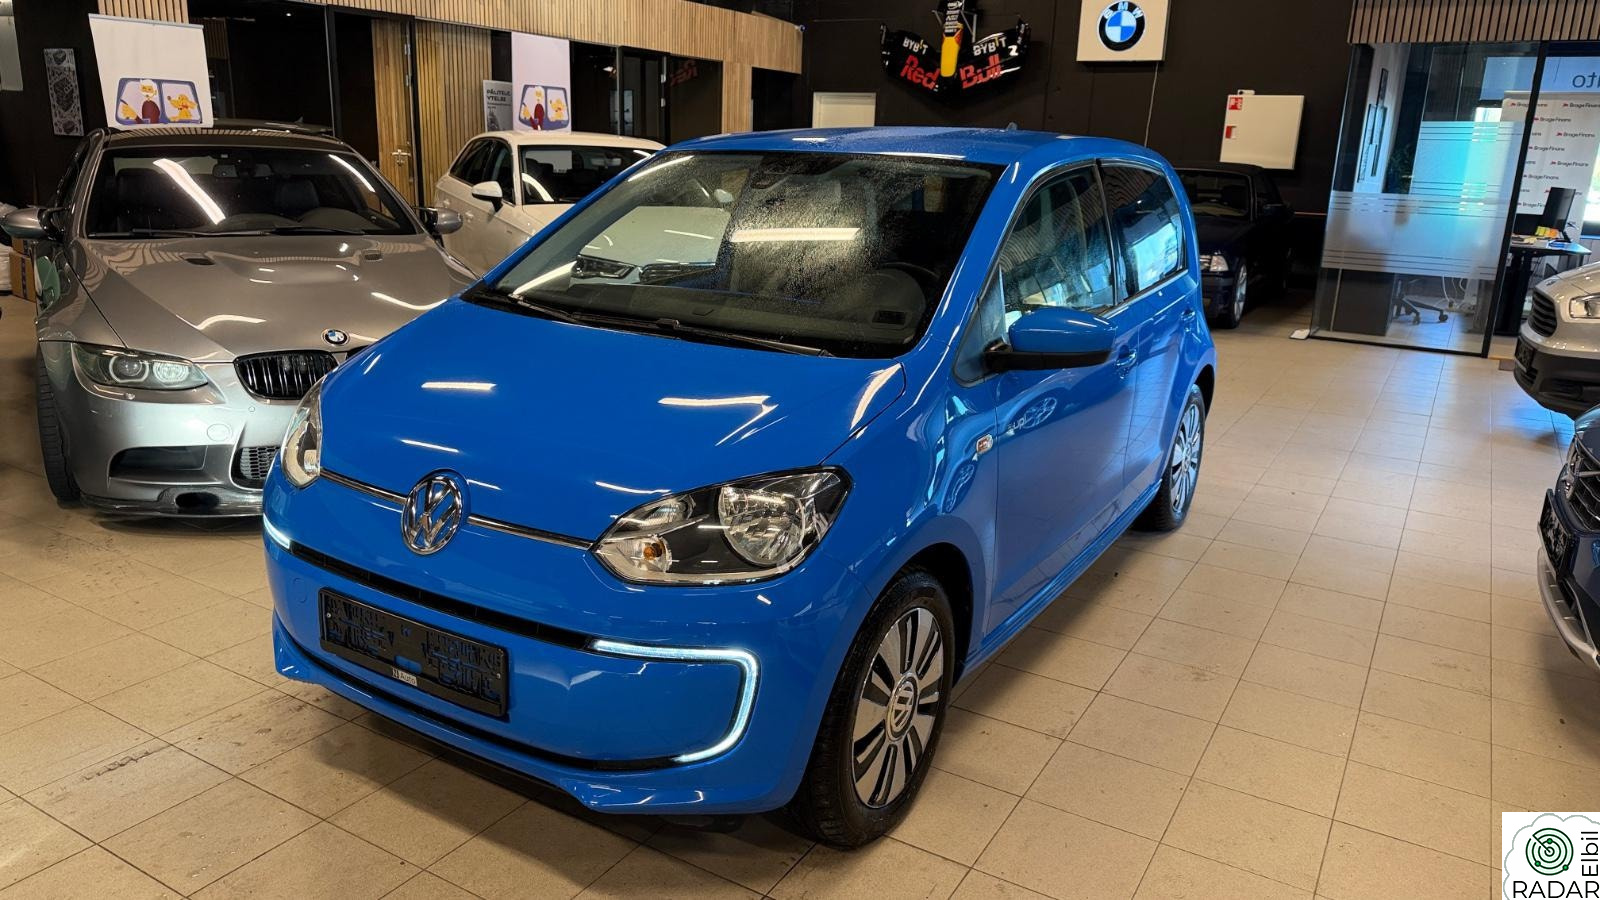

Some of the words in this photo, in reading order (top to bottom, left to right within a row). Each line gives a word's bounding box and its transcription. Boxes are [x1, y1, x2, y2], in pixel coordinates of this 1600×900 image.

[1103, 1, 1144, 19] BMW
[902, 37, 928, 55] BYBIT
[973, 36, 1007, 56] BYBIT
[901, 54, 940, 89] Red
[960, 54, 1001, 89] Bull
